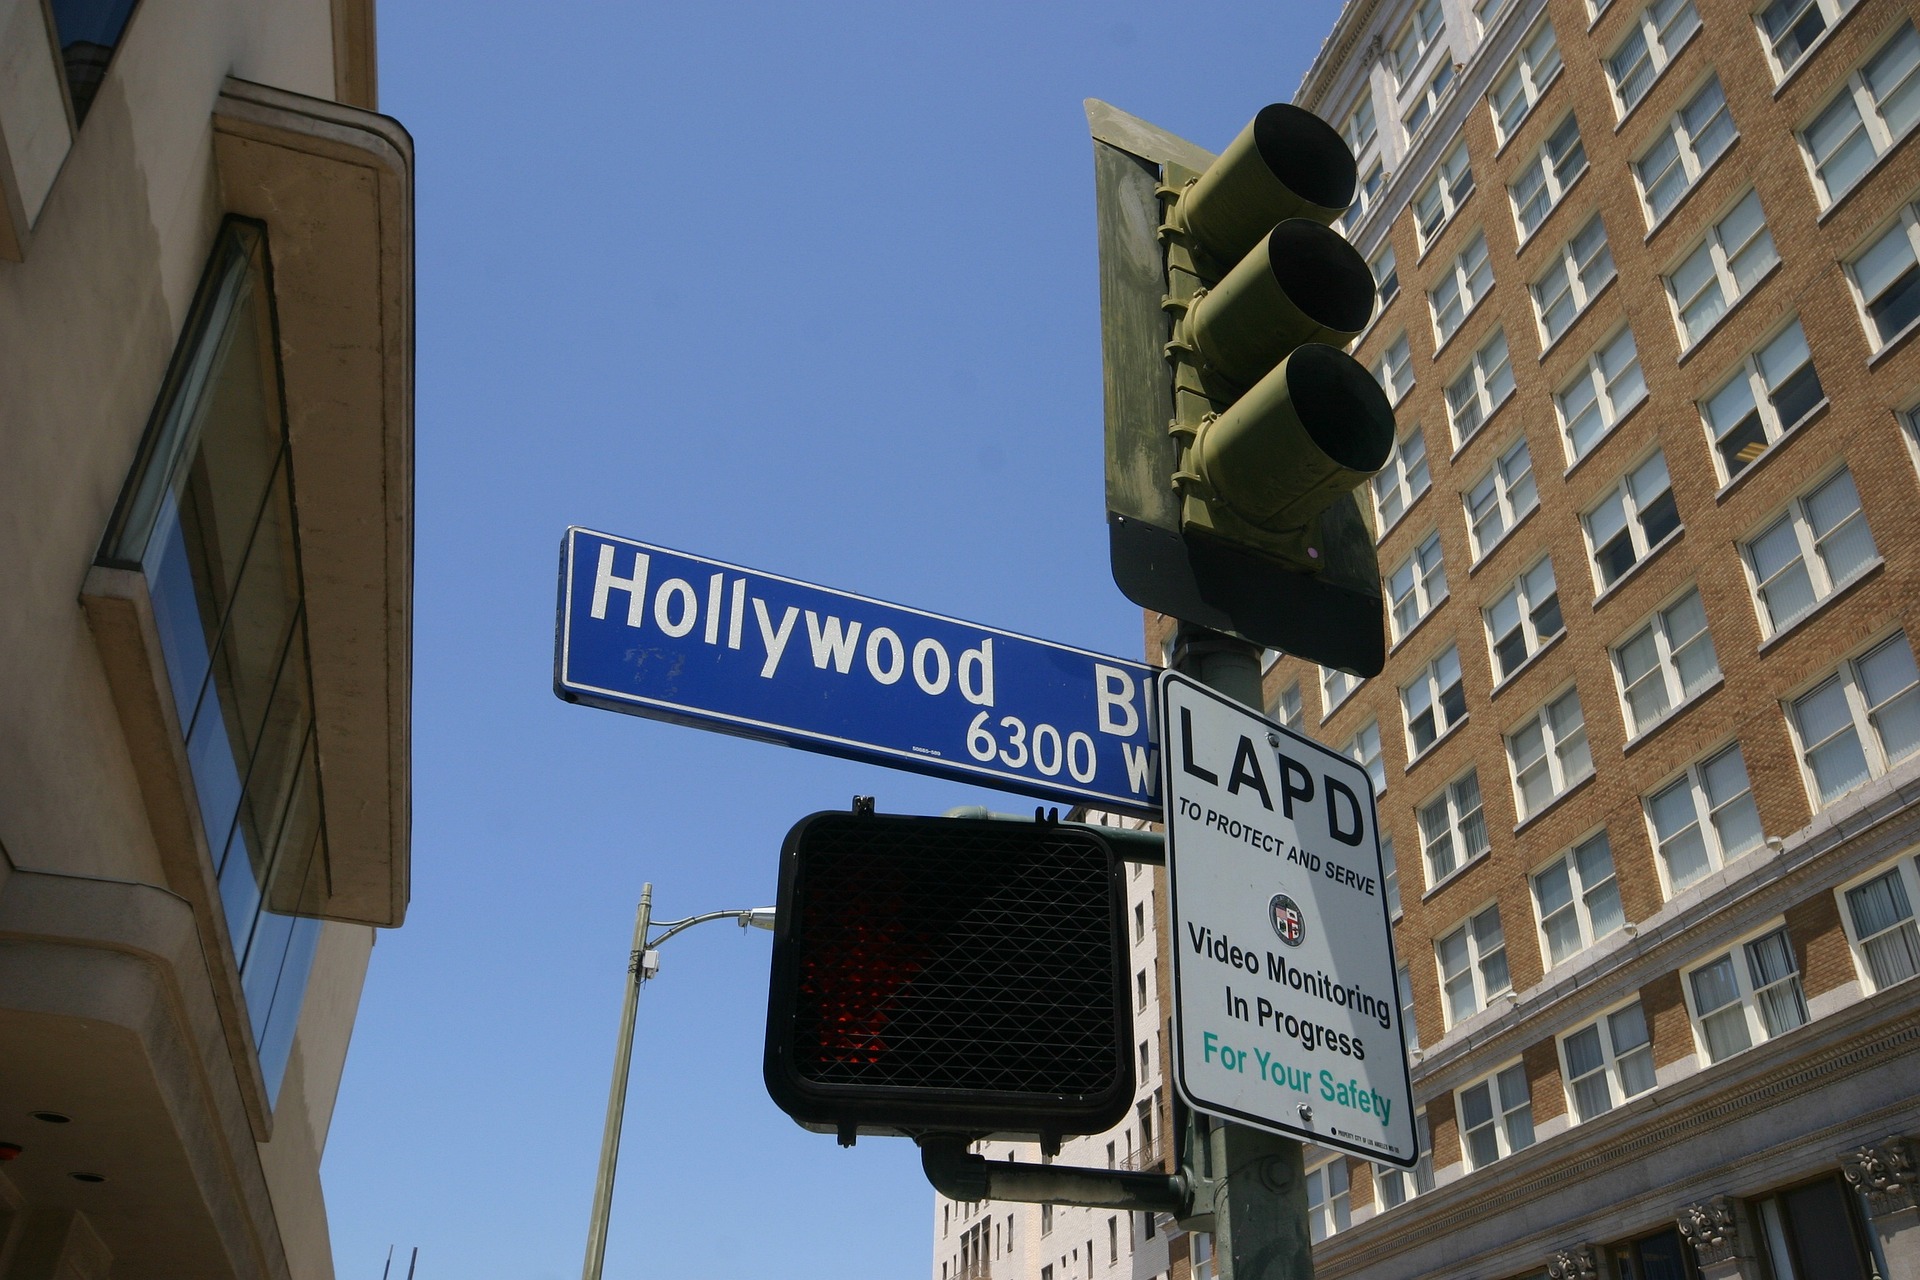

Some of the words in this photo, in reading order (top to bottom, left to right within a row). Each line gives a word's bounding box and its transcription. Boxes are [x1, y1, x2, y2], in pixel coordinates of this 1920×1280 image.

[591, 544, 994, 707] Hollywood
[1095, 663, 1159, 744] Bl
[966, 710, 1097, 784] 6300
[1121, 742, 1159, 798] W
[1180, 705, 1364, 847] LAPD
[1179, 796, 1201, 821] TO
[1205, 809, 1284, 857] PROTECT
[1287, 846, 1321, 873] AND
[1325, 861, 1375, 896] SERVE
[1187, 921, 1259, 974] Video
[1266, 951, 1391, 1030] Monitoring
[1225, 985, 1249, 1022] In
[1256, 996, 1365, 1061] Progress
[1203, 1031, 1247, 1073] For
[1253, 1047, 1312, 1094] Your
[1319, 1069, 1391, 1127] Safety
